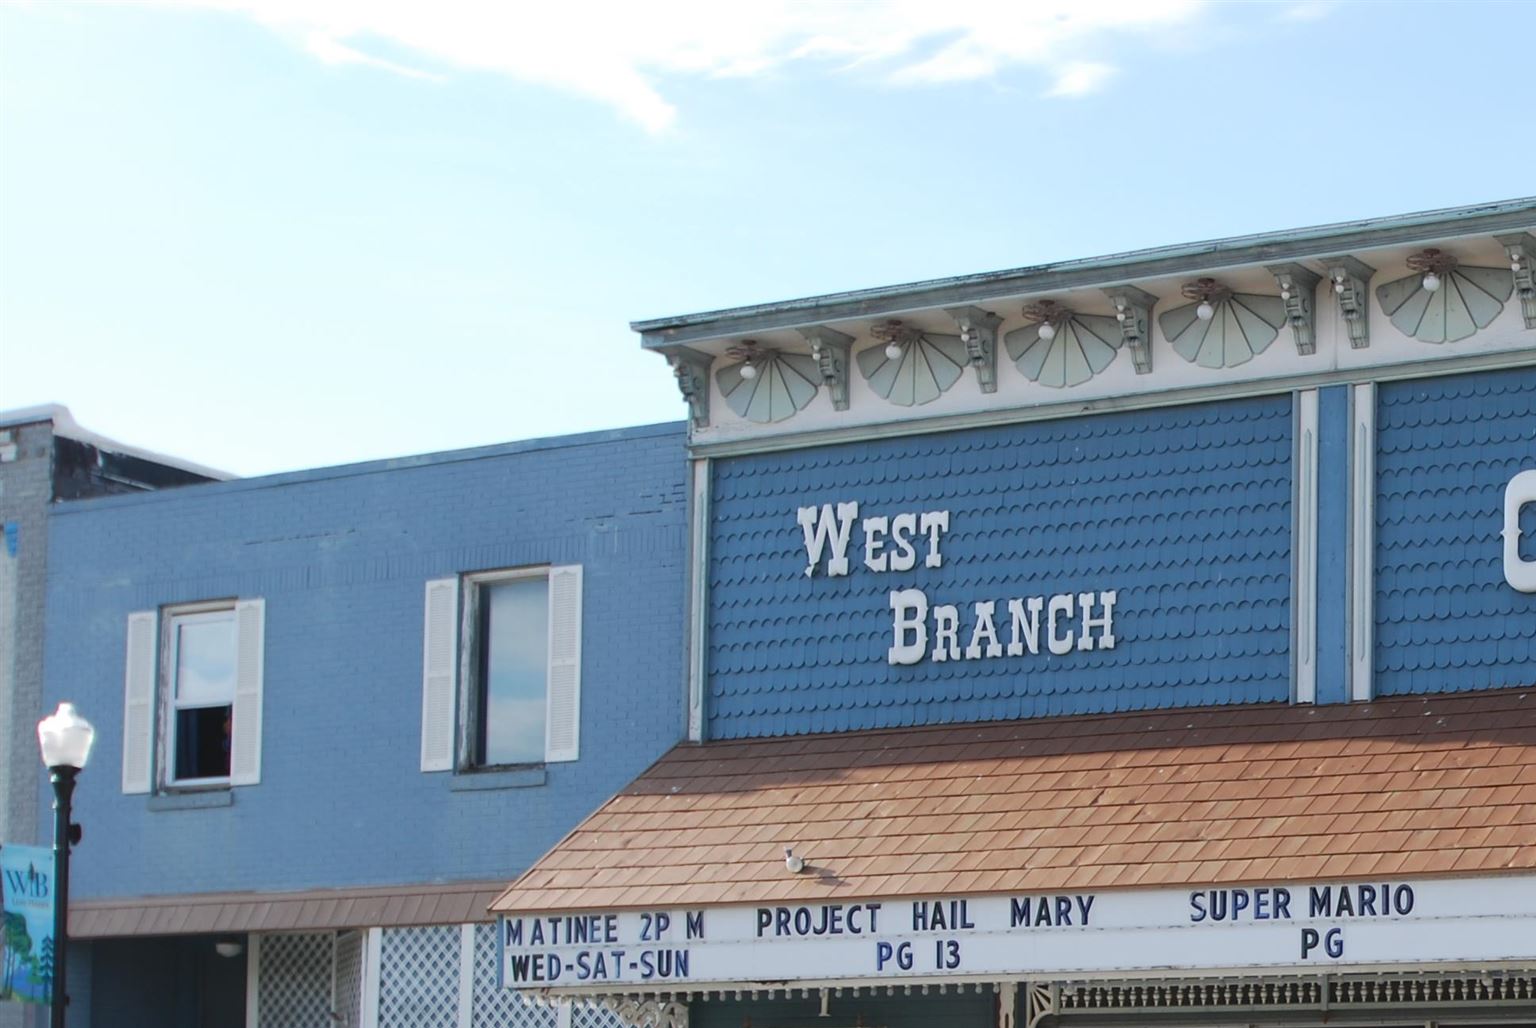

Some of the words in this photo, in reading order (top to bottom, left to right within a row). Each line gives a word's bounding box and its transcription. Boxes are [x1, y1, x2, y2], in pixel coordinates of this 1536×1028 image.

[756, 903, 882, 938] PROJECT
[911, 900, 975, 931] HAIL
[1009, 894, 1096, 928] MARY
[1190, 888, 1292, 923] SUPER
[1308, 883, 1416, 919] MARIO
[505, 914, 619, 946] MATINEE
[1300, 926, 1344, 960] PG
[511, 949, 690, 983] WED-SAT-SUN
[876, 940, 914, 972] PG
[935, 939, 961, 969] 13
